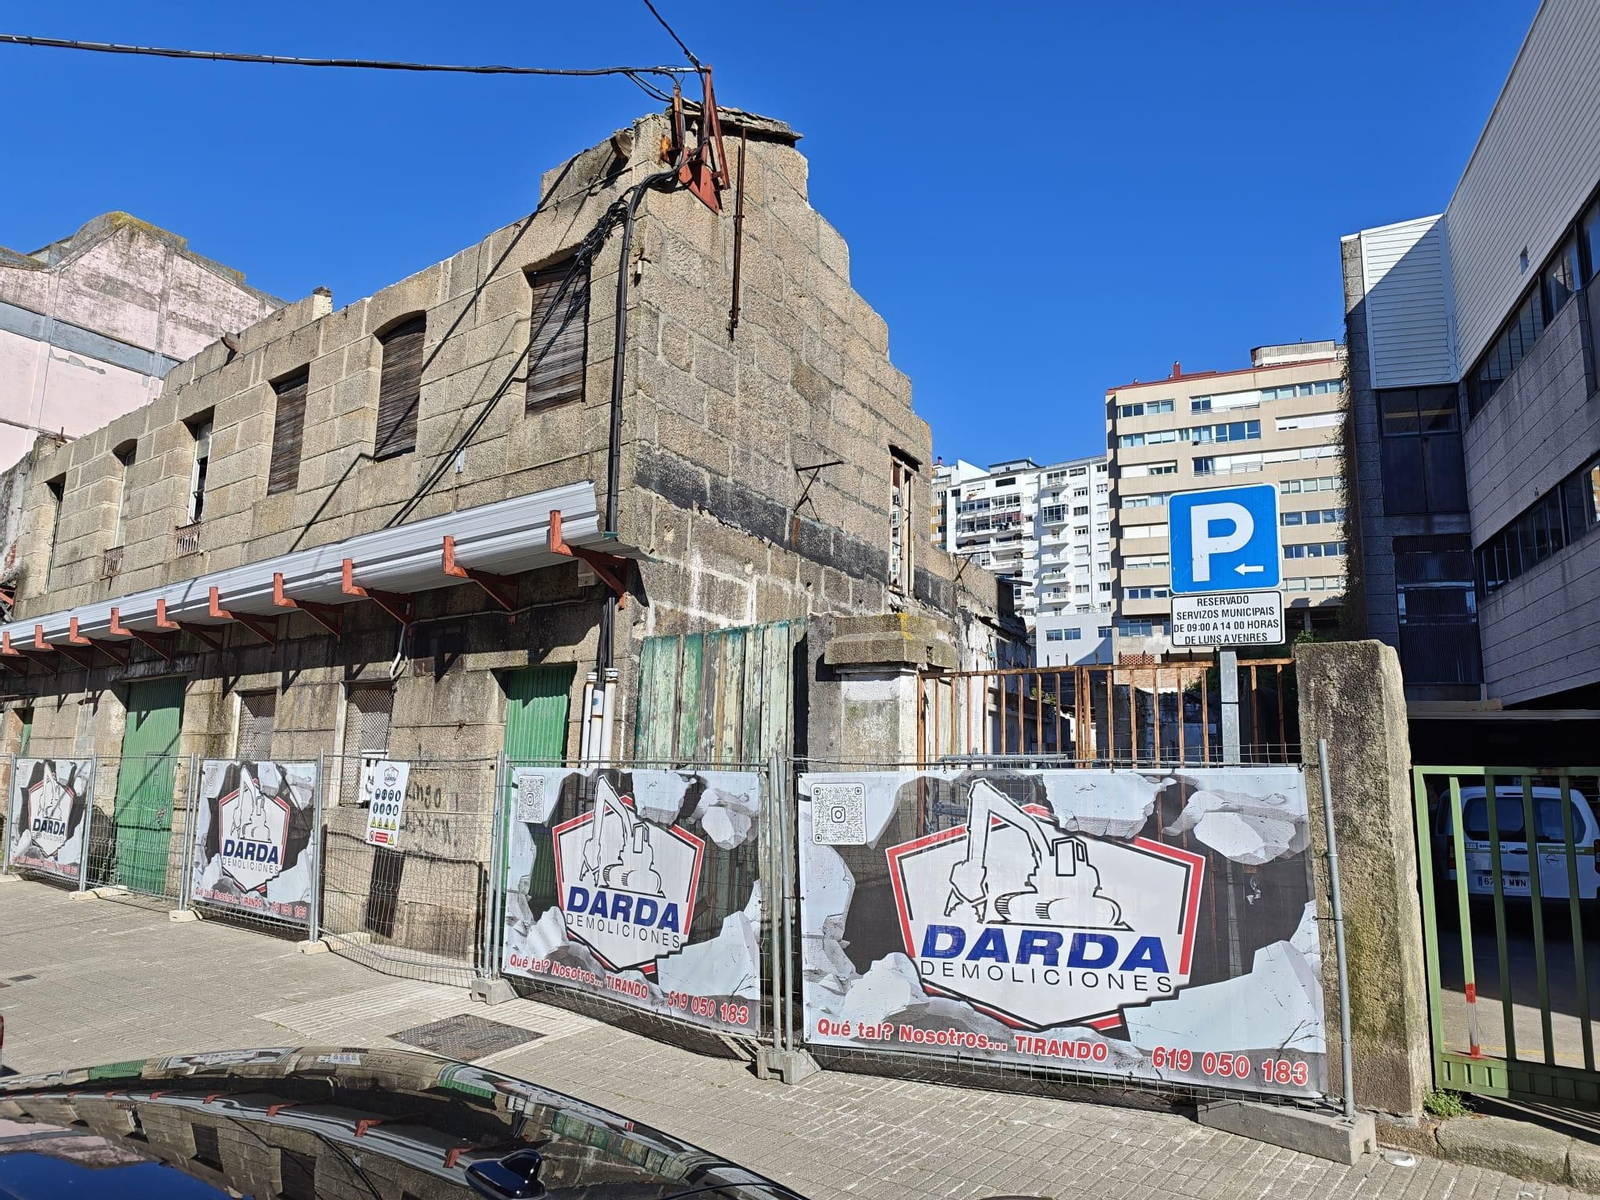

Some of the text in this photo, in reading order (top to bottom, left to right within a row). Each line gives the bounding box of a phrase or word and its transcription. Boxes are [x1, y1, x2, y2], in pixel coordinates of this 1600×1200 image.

[1190, 502, 1255, 582] P
[1176, 606, 1275, 621] SERVIZOS MUNICIPAIS
[1197, 595, 1249, 607] RESERVADO
[1173, 623, 1185, 633] DE
[1186, 622, 1211, 632] 09:00
[1212, 622, 1219, 631] A
[1247, 618, 1279, 630] HORAS
[1184, 632, 1268, 644] DE LUNS A VENRES
[32, 818, 66, 836] DARDA
[223, 839, 279, 865] DARDA
[222, 857, 279, 875] DEMOLICIONES
[1484, 877, 1506, 885] 671
[566, 886, 680, 933] DARDA
[566, 913, 681, 949] DEMOLICIONES
[921, 924, 1169, 974] DARDA
[509, 953, 528, 968] Qué
[531, 957, 550, 974] tal?
[606, 974, 649, 999] TIRANDO
[668, 990, 688, 1010] 619
[691, 996, 716, 1018] 050
[720, 1003, 749, 1025] 183
[920, 960, 1173, 993] DEMOLICIONES
[817, 1018, 1309, 1086] Qué tal? Nosotros... TIRANDO 619 050 183
